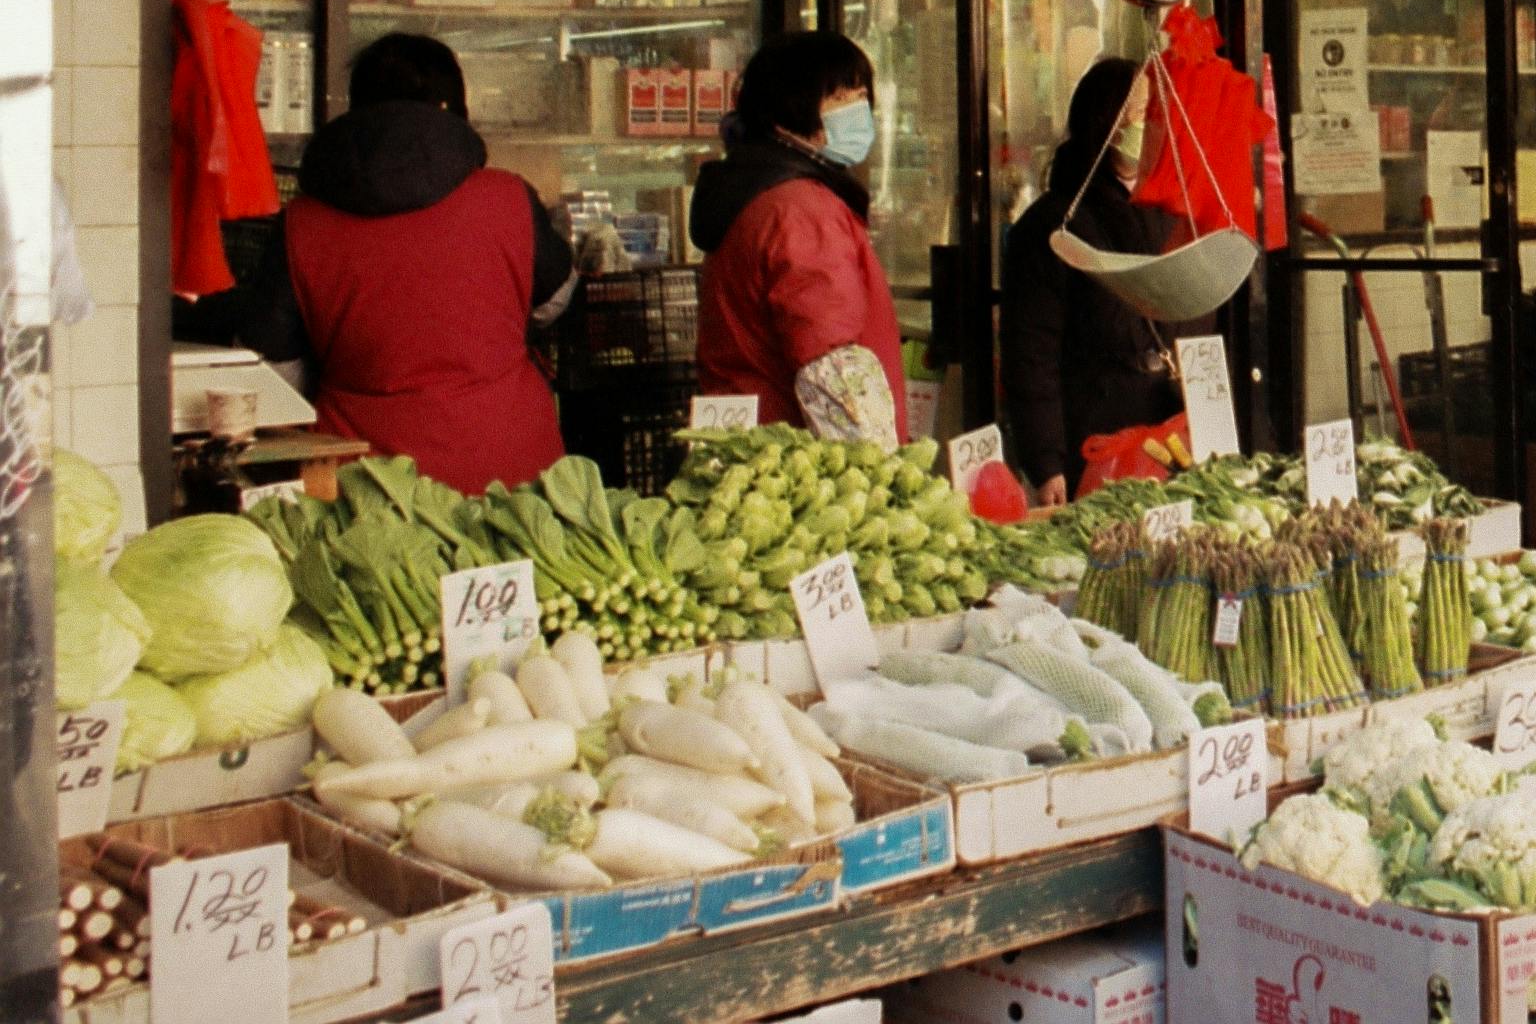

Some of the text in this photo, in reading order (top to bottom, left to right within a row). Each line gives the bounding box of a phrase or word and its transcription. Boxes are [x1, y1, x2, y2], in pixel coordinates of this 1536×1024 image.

[57, 766, 103, 792] LB
[1233, 770, 1261, 800] LB
[227, 923, 277, 963] LB
